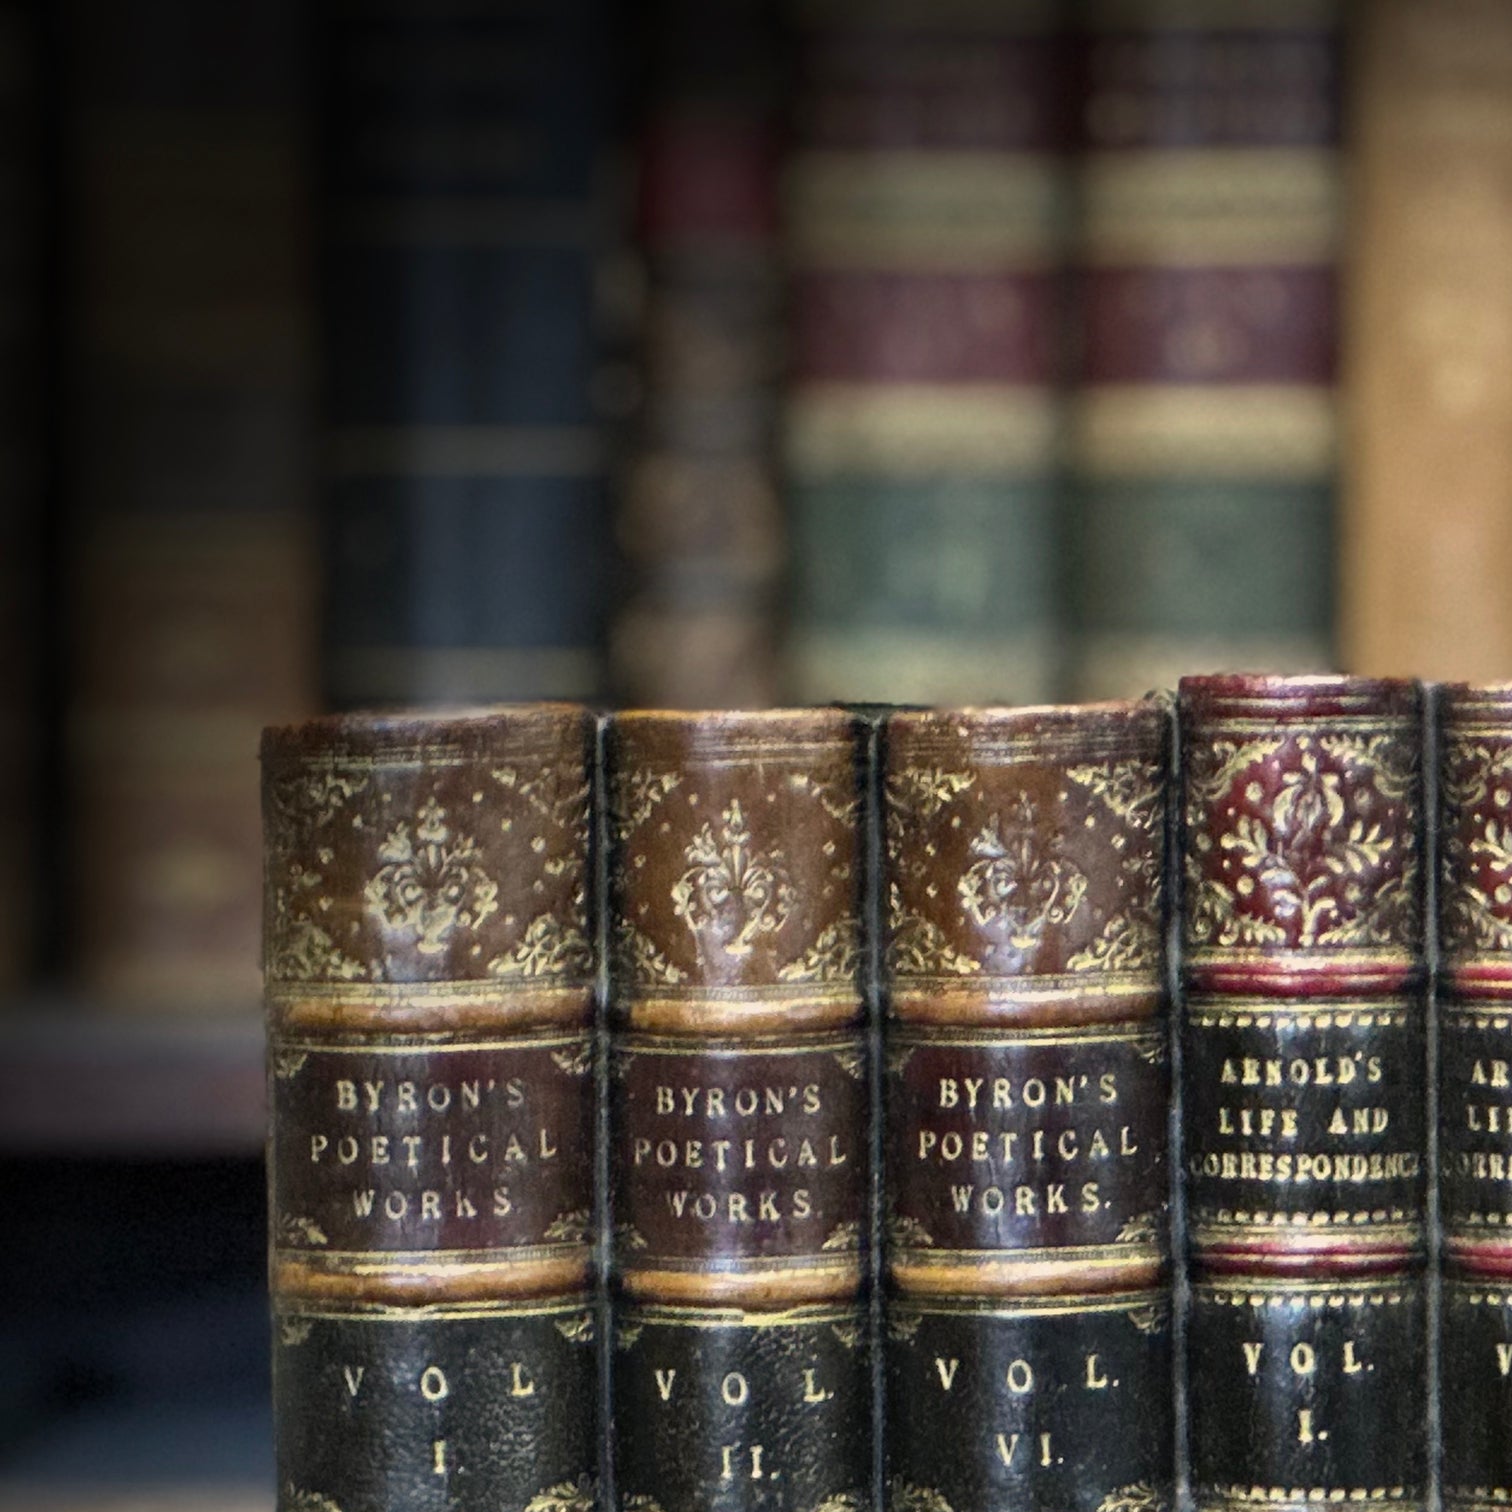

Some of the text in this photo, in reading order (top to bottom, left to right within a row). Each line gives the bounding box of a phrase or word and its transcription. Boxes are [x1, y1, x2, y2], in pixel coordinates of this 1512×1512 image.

[1220, 1050, 1383, 1086] ARNOLD'S
[336, 1078, 526, 1113] BYRON'S
[655, 1084, 821, 1117] BYRON'S
[939, 1074, 1118, 1109] BYRON'S
[1219, 1107, 1390, 1137] LIFE AND
[311, 1129, 557, 1166] POETICAL
[634, 1138, 847, 1170] POETICAL
[919, 1125, 1139, 1163] POETICAL
[950, 1182, 1113, 1217] WORKS.
[936, 1355, 1121, 1395] VOL.
[1242, 1341, 1376, 1376] VOL.
